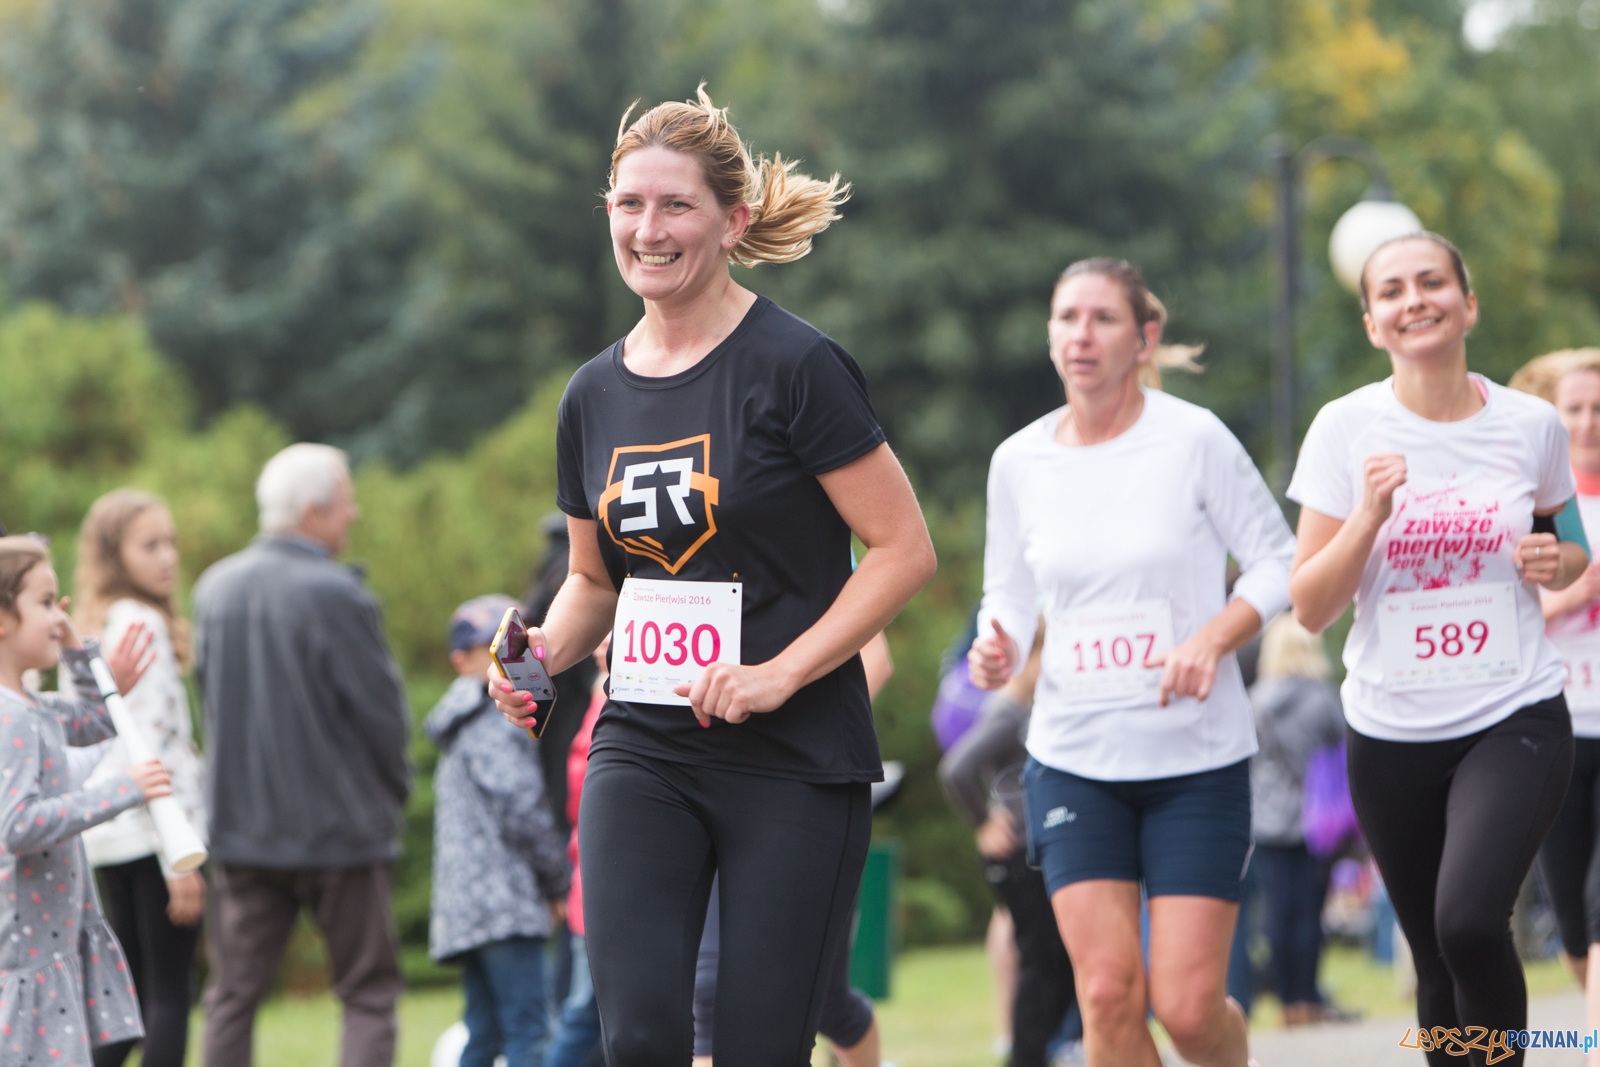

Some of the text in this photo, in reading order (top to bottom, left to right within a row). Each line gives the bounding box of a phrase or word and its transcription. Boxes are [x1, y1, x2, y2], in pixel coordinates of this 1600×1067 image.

[1403, 518, 1492, 535] zawsze
[633, 592, 711, 605] Zawsze Pier(w)si 2016
[624, 620, 721, 667] 1030
[1072, 632, 1156, 673] 1107
[1415, 620, 1490, 659] 589
